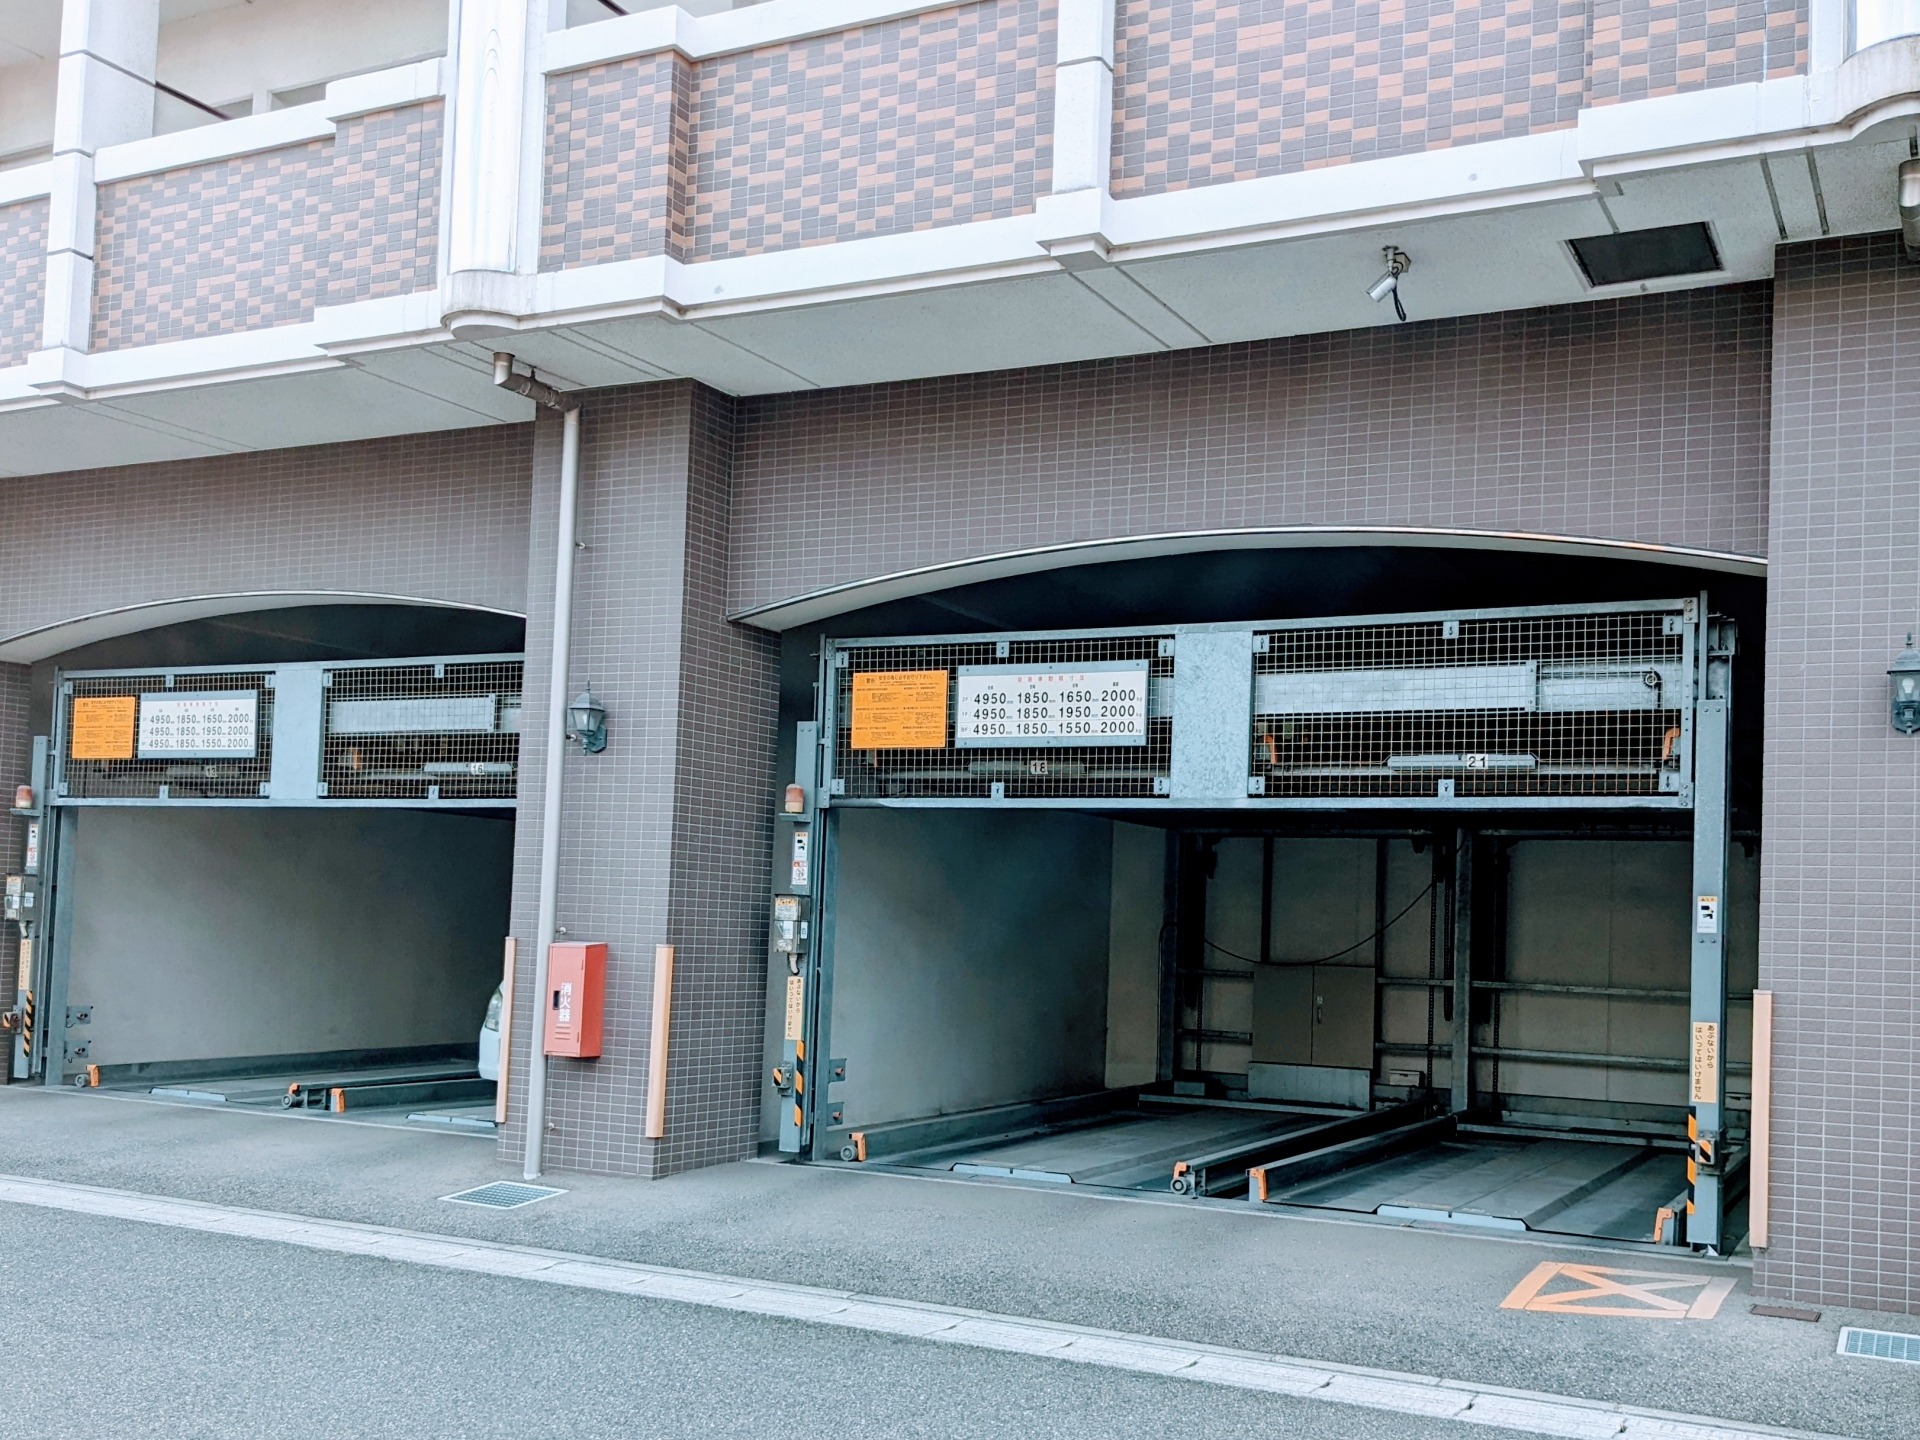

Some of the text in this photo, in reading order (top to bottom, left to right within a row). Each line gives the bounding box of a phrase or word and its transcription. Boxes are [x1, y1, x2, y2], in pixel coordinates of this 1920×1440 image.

[1468, 756, 1486, 768] 21
[559, 982, 572, 1021] 消火器
[1694, 1026, 1703, 1100] はいってはいけません
[1707, 1024, 1715, 1069] あぶないから
